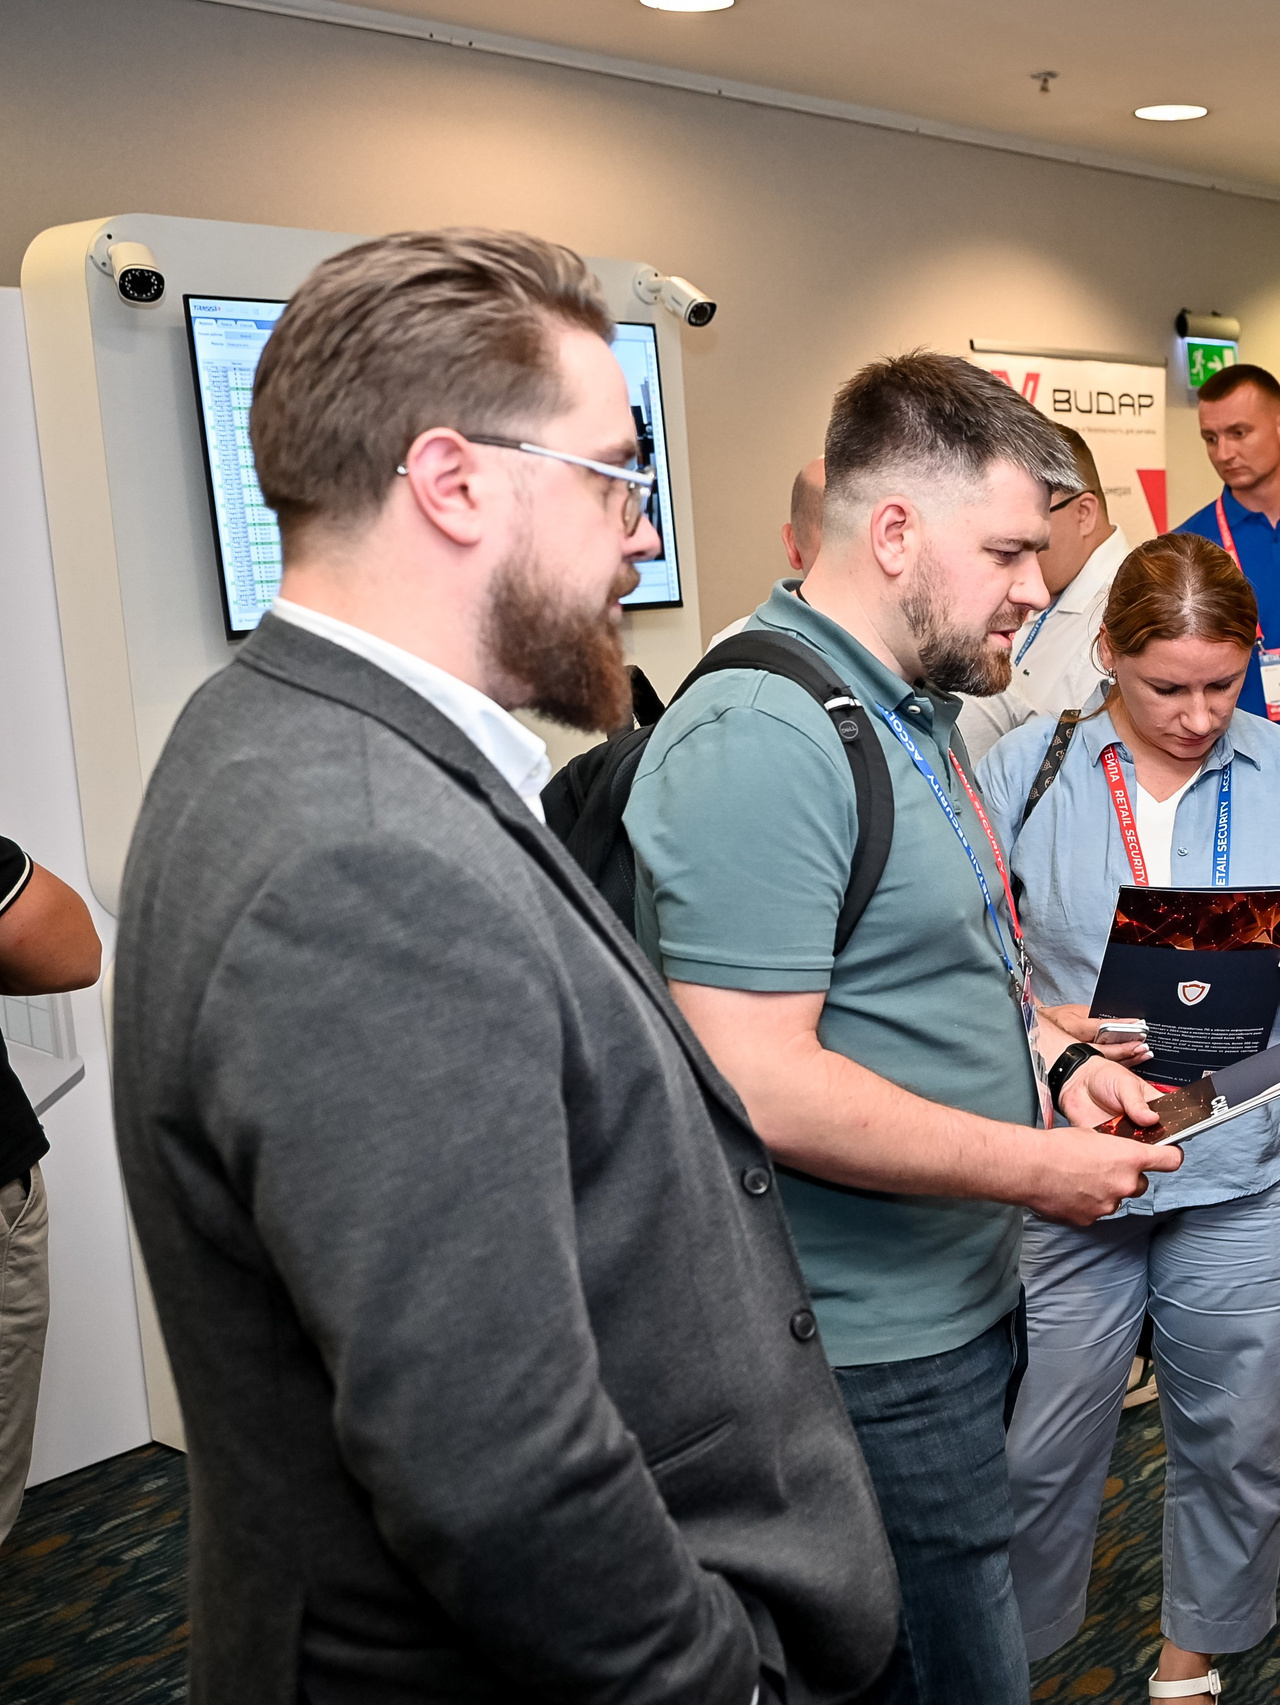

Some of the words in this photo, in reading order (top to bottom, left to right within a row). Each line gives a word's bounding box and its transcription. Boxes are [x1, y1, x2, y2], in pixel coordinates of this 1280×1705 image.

[926, 774, 968, 848] SECURITY
[974, 800, 1005, 873] SECURITY
[1114, 789, 1131, 827] RETAIL
[1125, 829, 1146, 884] SECURITY
[1217, 801, 1229, 852] SECURITY
